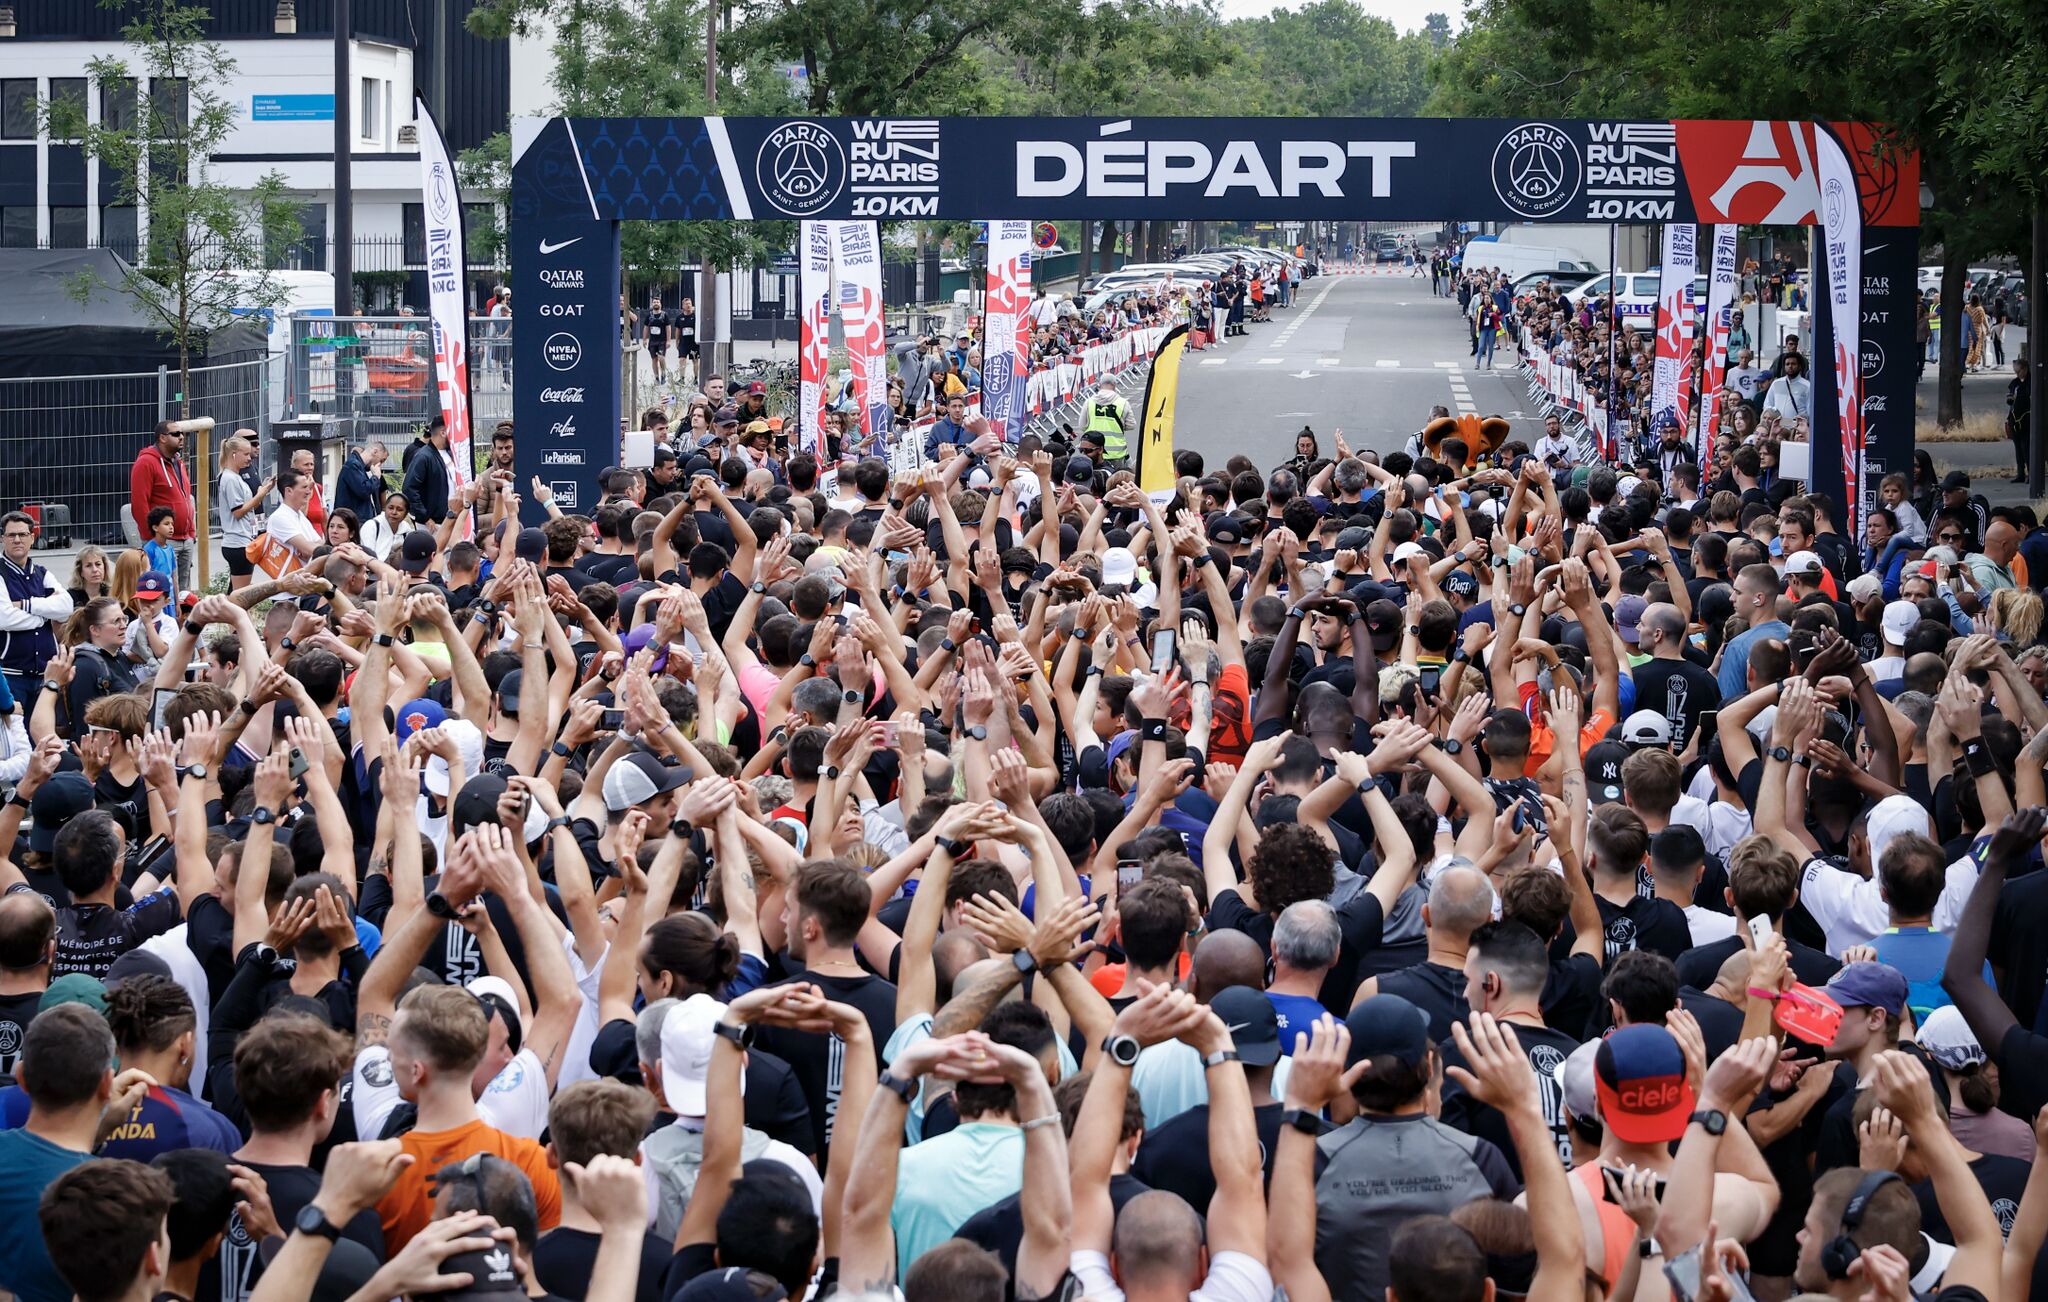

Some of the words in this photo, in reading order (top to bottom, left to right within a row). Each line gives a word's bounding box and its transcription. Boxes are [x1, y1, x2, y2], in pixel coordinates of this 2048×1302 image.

[771, 126, 831, 149] PARIS
[851, 120, 940, 139] WE
[1506, 127, 1567, 151] PARIS
[1587, 123, 1676, 143] WE
[851, 141, 940, 161] RUN
[1016, 119, 1416, 198] DÉPART
[1586, 144, 1676, 164] RUN
[851, 163, 940, 182] PARIS
[1586, 166, 1676, 186] PARIS
[772, 188, 793, 207] SAINT
[798, 189, 831, 208] GERMAIN
[1506, 190, 1528, 208] SAINT
[1533, 191, 1567, 210] GERMAIN
[1673, 243, 1692, 252] PARIS
[540, 270, 584, 283] QATAR
[551, 281, 584, 289] AIRWAYS
[1863, 277, 1889, 288] TAR
[540, 304, 584, 316] GOAT
[548, 345, 577, 354] NIVEA
[1862, 353, 1880, 361] VEA
[991, 357, 1001, 391] PARIS
[1602, 761, 1617, 779] NY
[59, 938, 105, 950] MÉMOIRE
[108, 936, 123, 945] DE
[1621, 1082, 1679, 1107] ciele
